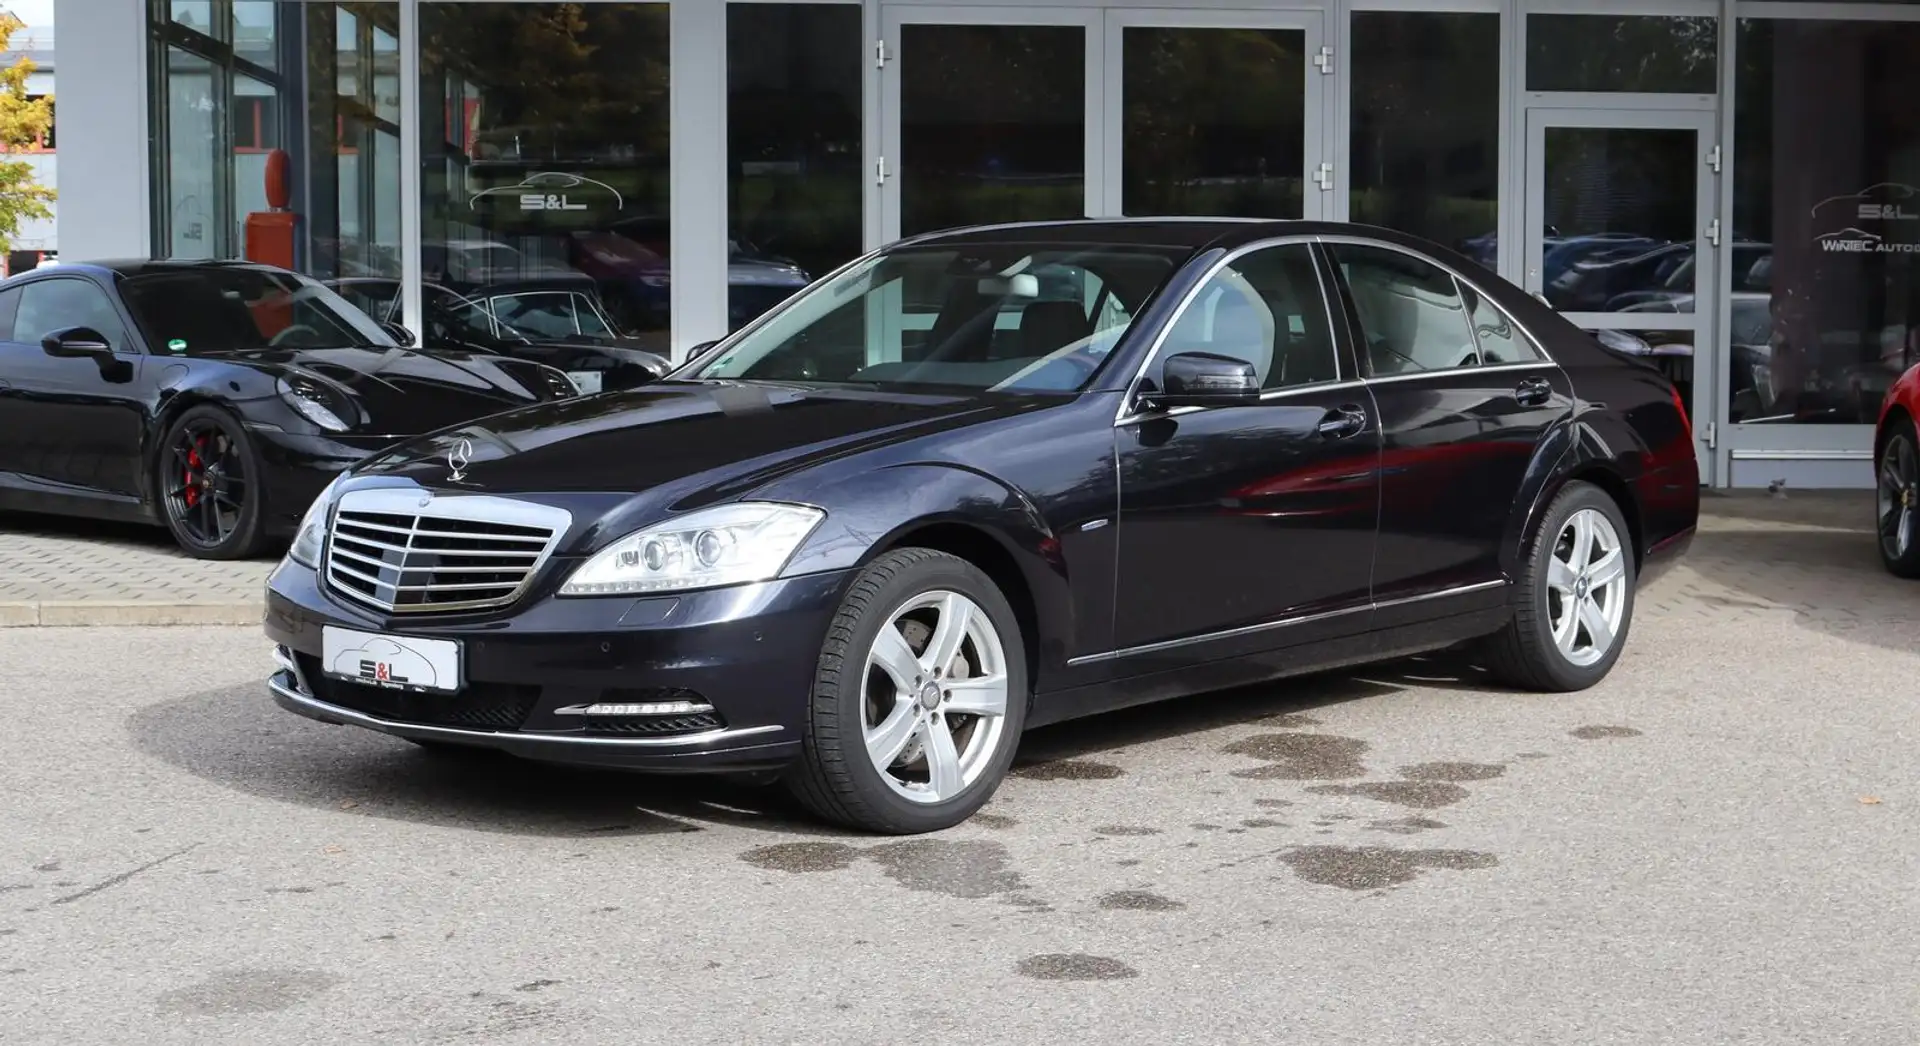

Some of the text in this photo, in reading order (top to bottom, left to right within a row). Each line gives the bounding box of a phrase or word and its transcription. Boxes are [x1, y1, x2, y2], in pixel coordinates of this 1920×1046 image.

[520, 194, 587, 210] S&L
[1858, 204, 1919, 219] S&L
[360, 659, 409, 682] S&L
